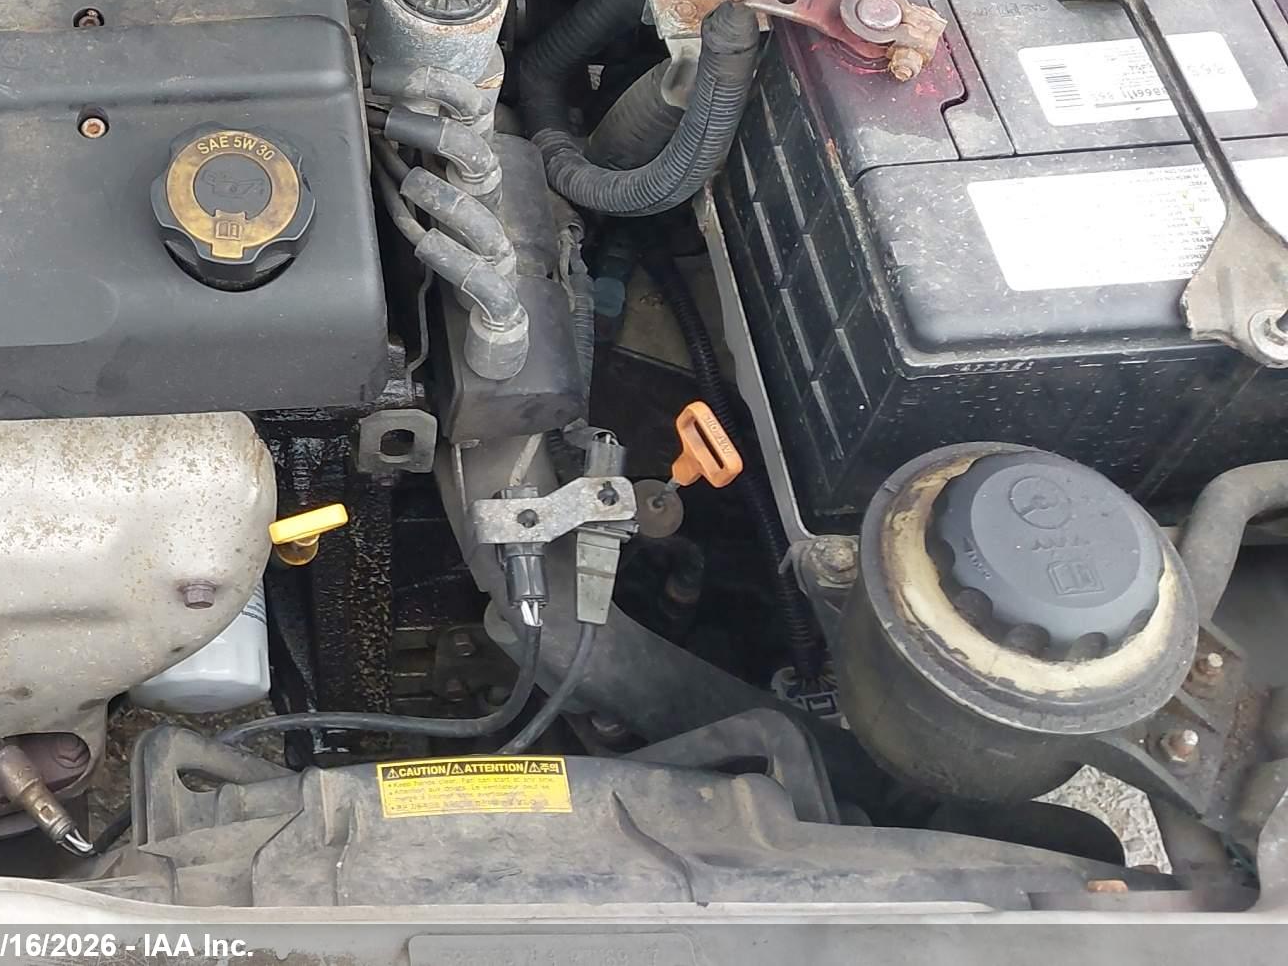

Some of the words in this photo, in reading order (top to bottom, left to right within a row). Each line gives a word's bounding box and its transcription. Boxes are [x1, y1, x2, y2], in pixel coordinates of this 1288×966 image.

[196, 136, 229, 155] SAE
[233, 137, 257, 151] 5W
[255, 142, 275, 161] 30
